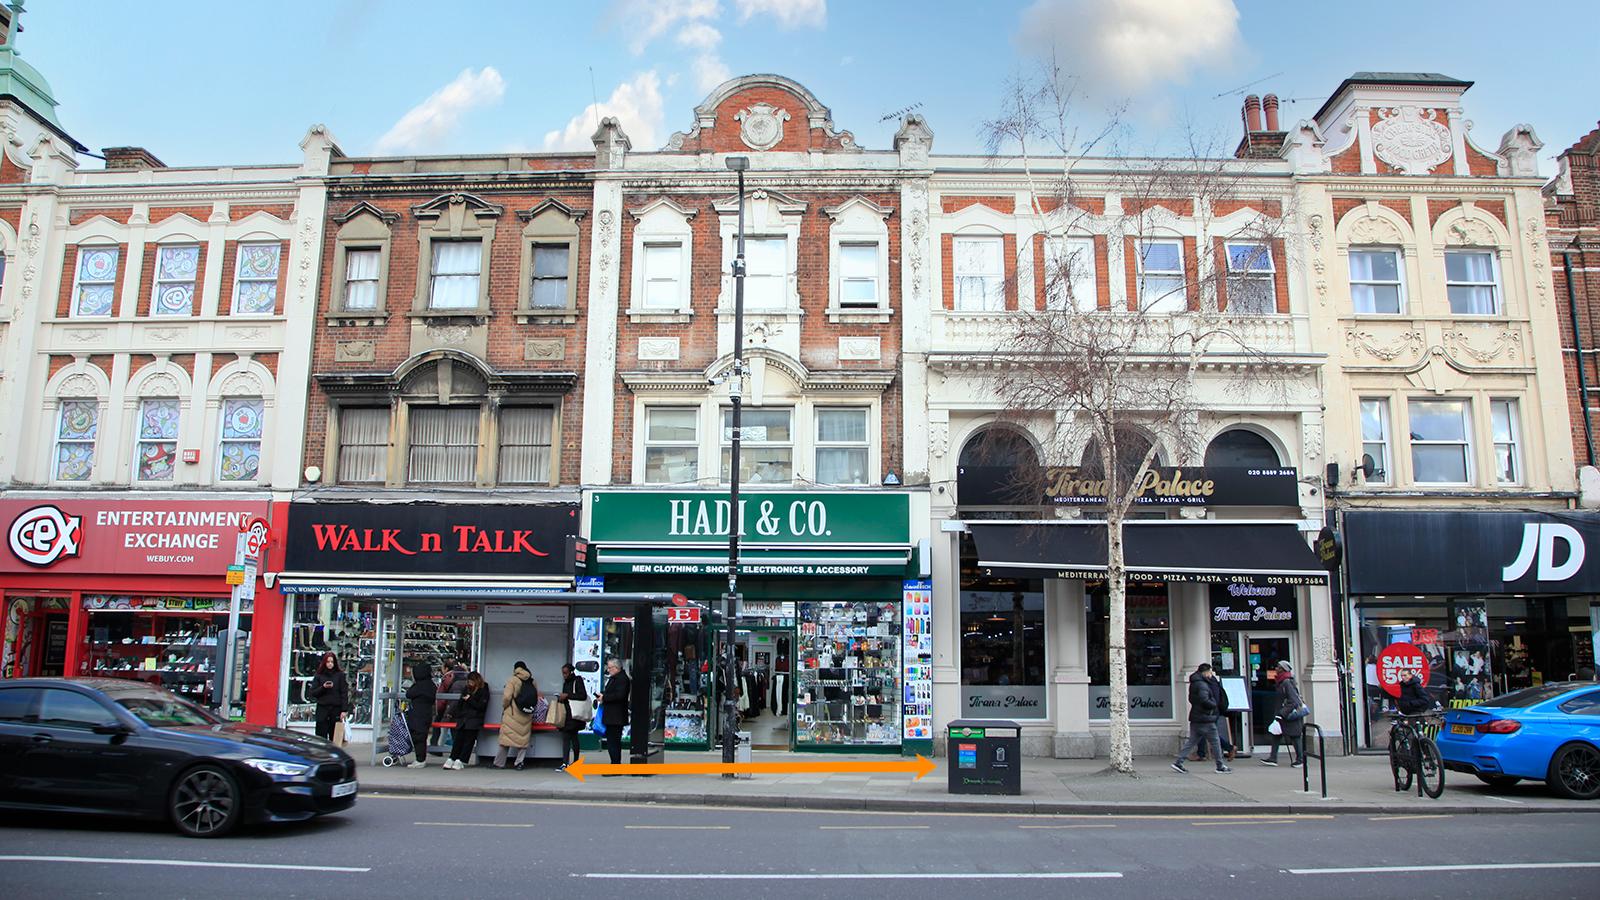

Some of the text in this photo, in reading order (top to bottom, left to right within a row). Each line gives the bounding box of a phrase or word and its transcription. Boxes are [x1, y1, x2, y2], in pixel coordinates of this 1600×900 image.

[1045, 466, 1215, 497] Tiran Palace
[668, 500, 832, 536] HADI & CO.
[124, 533, 219, 549] EXCHANGE
[420, 533, 443, 553] n
[146, 555, 194, 563] WEBUY.COM
[1502, 523, 1586, 582] JD
[632, 565, 651, 573] MEN
[653, 565, 699, 573] CLOTHING
[705, 566, 737, 574] SHOE
[743, 566, 804, 574] ELECTRONICS
[816, 567, 869, 575] ACCESSORY
[1058, 571, 1127, 579] MEDITERRAN
[1129, 573, 1153, 581] FOOD
[1162, 574, 1187, 582] PIZZA
[1196, 575, 1222, 583] PASTA
[1227, 583, 1277, 597] Welcome
[1213, 607, 1292, 622] Tirana Palace
[1382, 656, 1423, 668] SALE
[969, 695, 1039, 707] Tirana Palace
[1131, 696, 1164, 708] Palace
